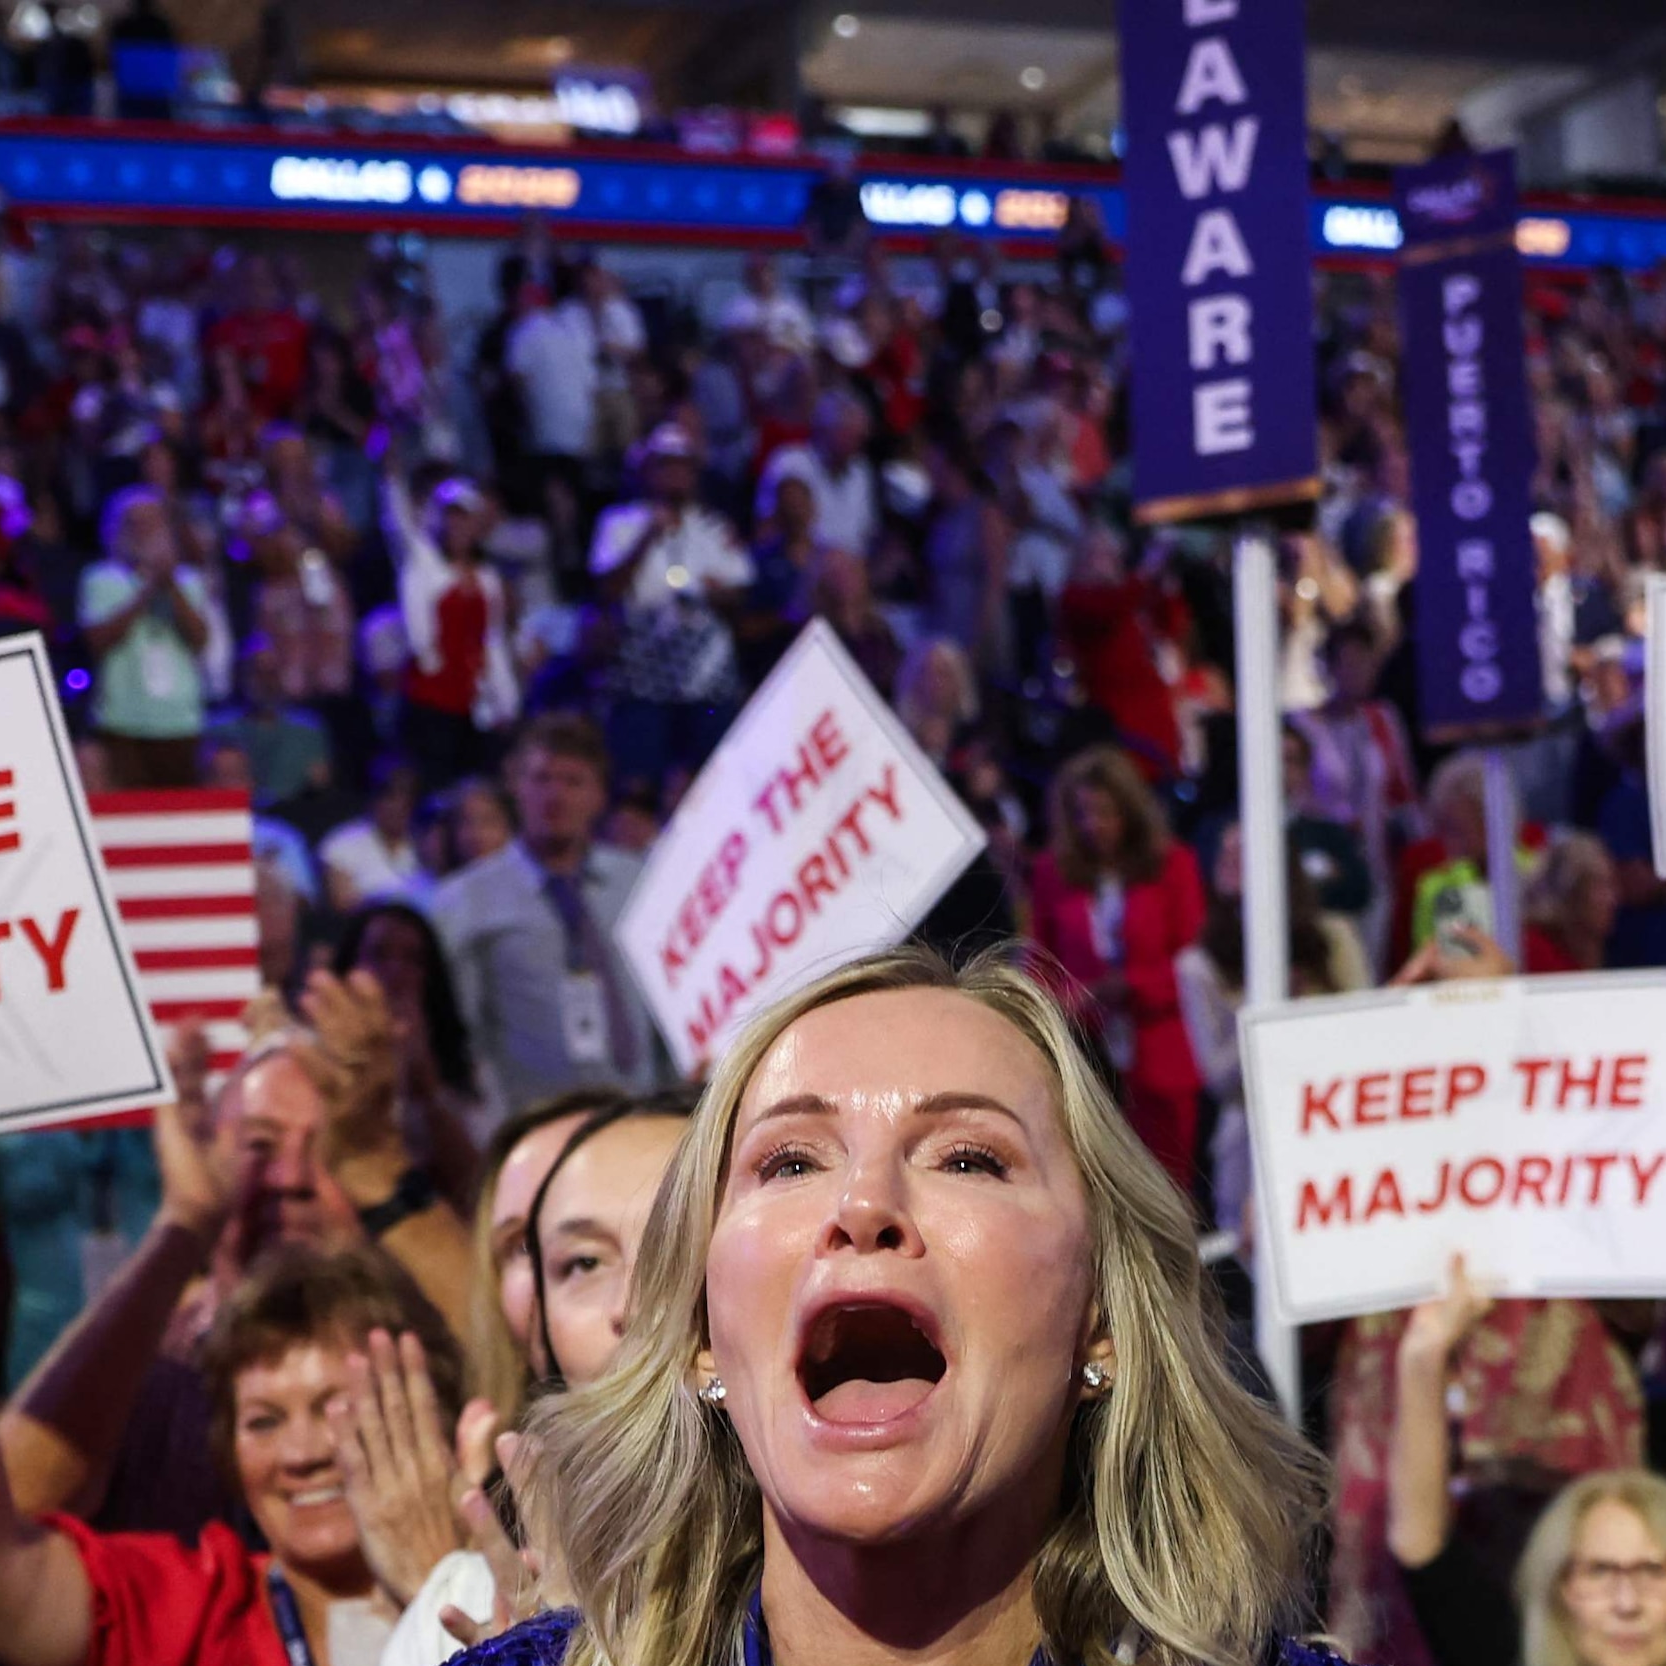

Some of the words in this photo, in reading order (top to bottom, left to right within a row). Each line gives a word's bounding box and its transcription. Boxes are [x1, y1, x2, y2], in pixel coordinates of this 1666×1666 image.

[1442, 274, 1493, 520] PUERTO
[1456, 539, 1502, 703] RICO
[656, 831, 750, 986] KEEP
[752, 708, 851, 836] THE
[684, 765, 904, 1050] MAJORITY
[1298, 1063, 1487, 1136] KEEP
[1512, 1054, 1650, 1111] THE
